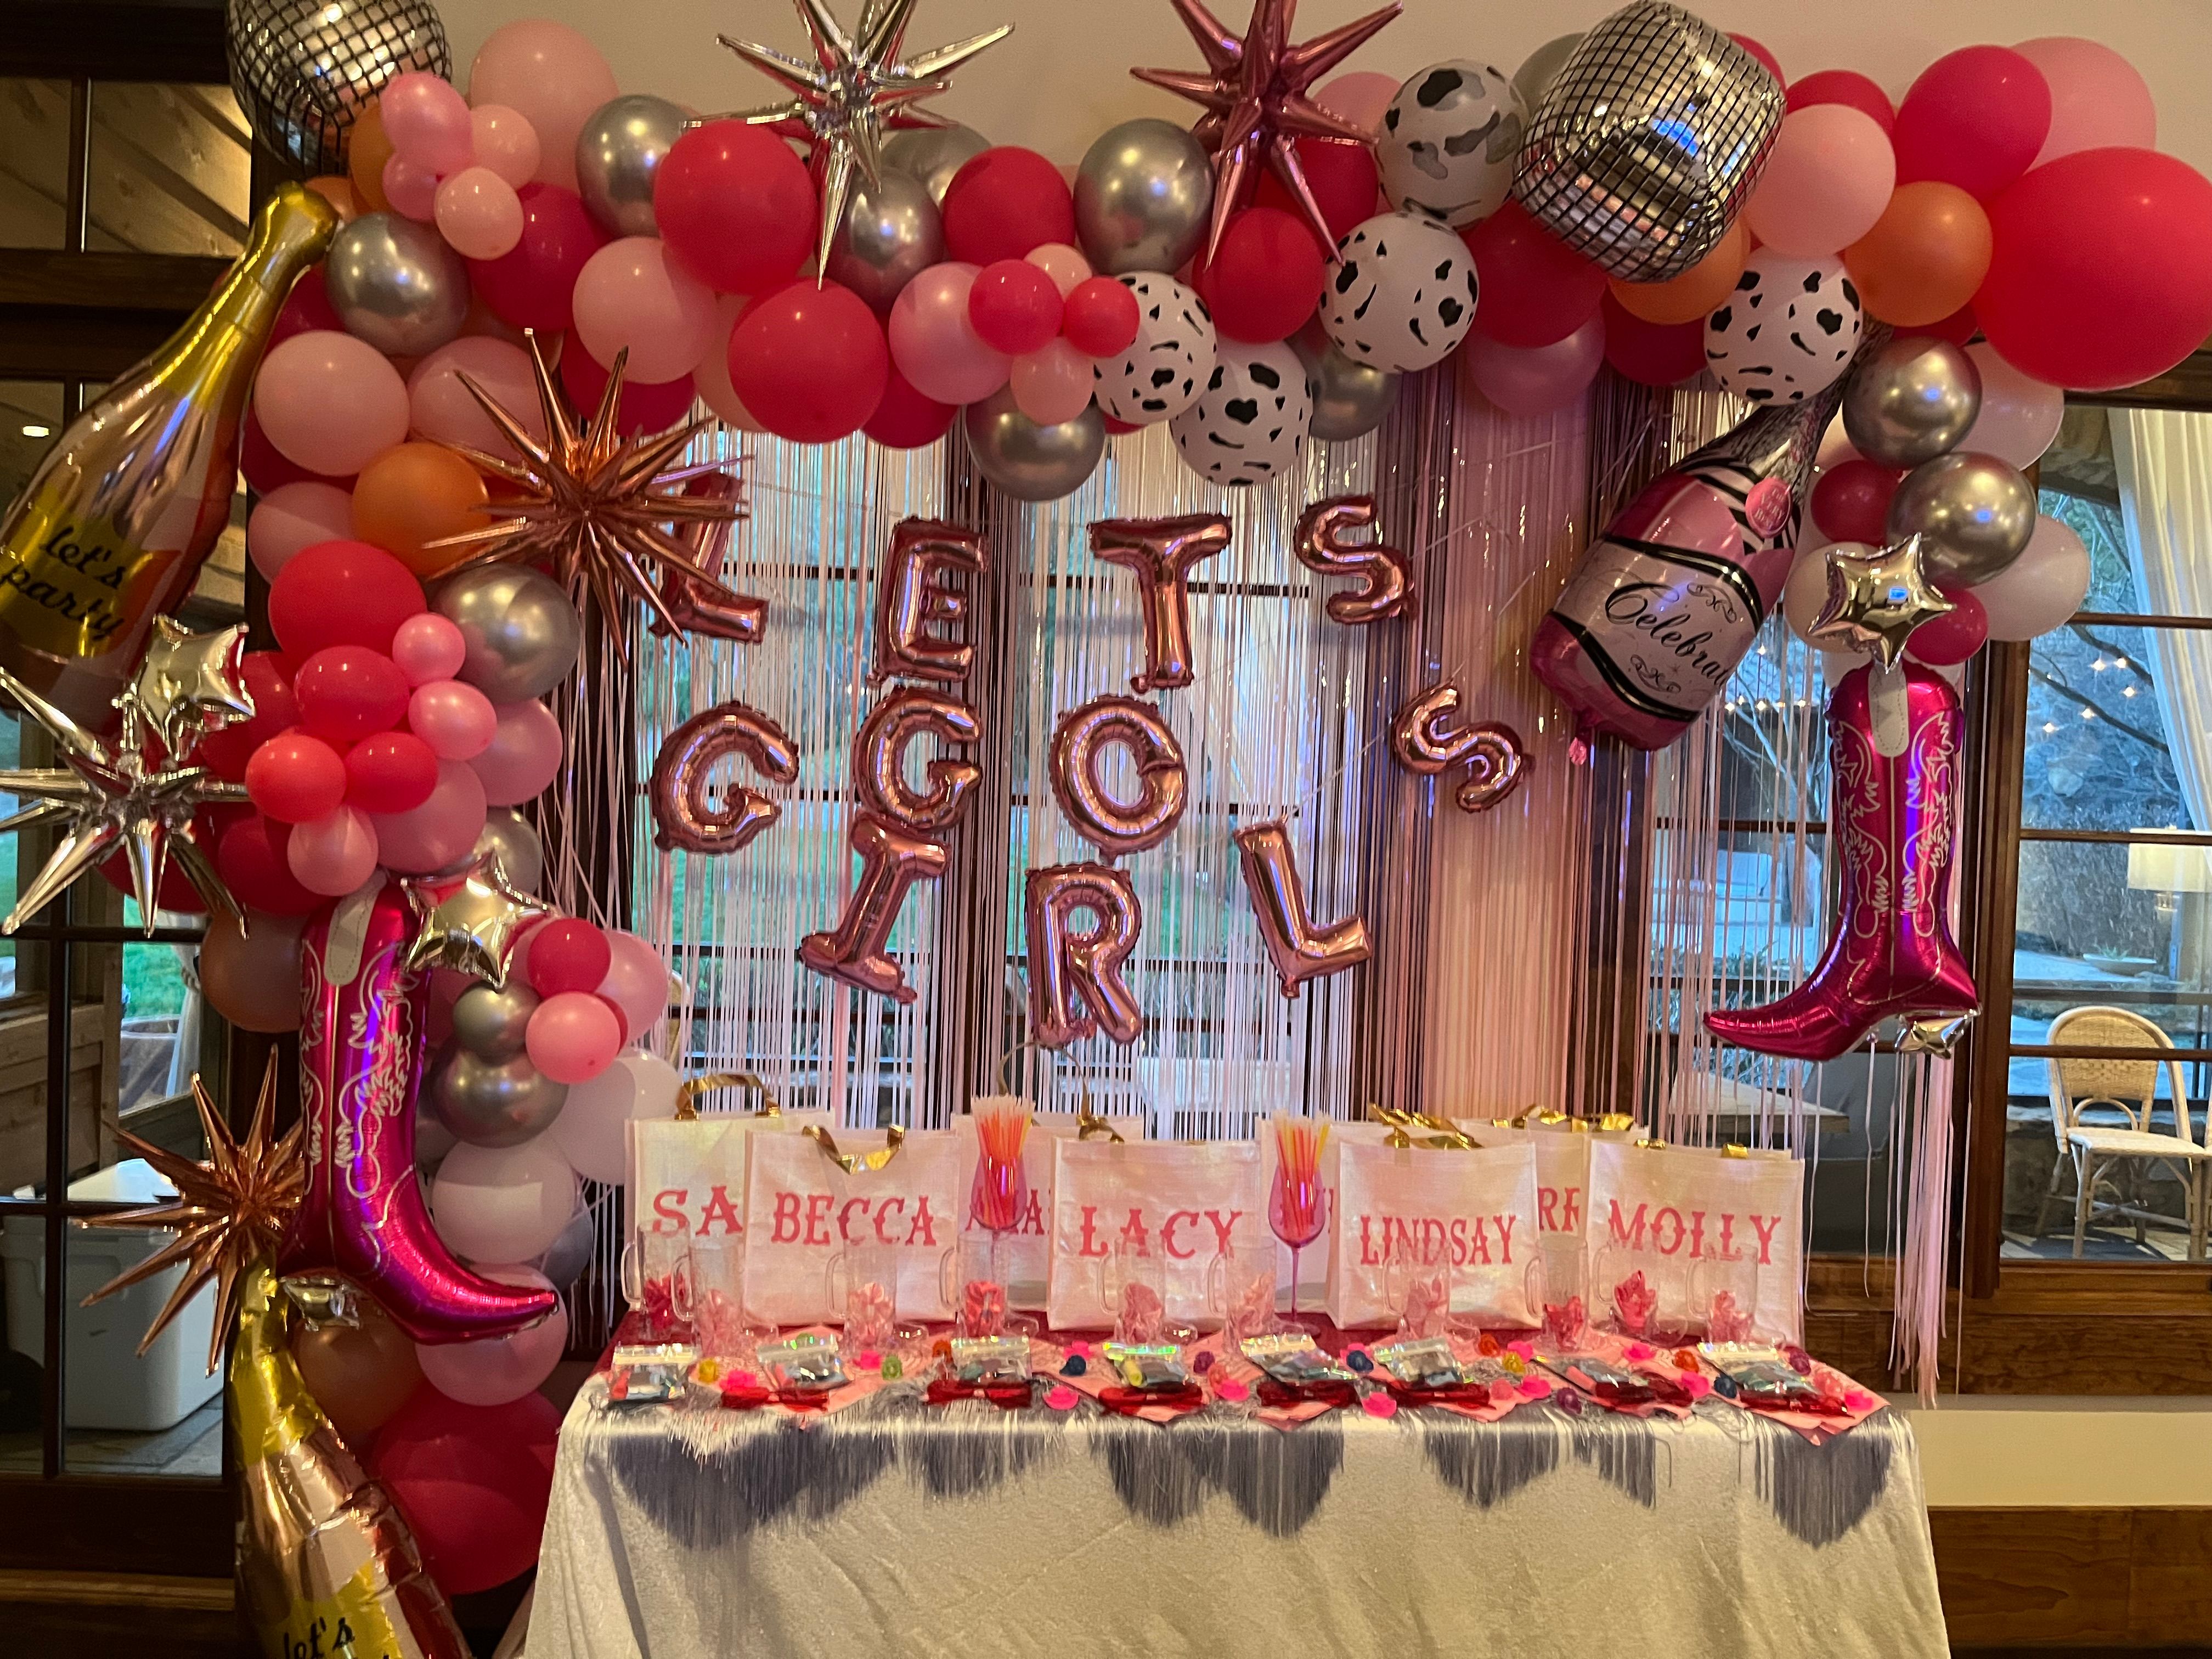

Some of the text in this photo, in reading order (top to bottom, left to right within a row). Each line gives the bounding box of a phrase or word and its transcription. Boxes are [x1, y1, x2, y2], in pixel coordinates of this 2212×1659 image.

[38, 526, 126, 590] let's
[0, 563, 125, 642] party
[770, 1192, 937, 1247] BECCA
[1079, 1206, 1243, 1260] LACY
[1360, 1214, 1516, 1266] LINDSAY
[1608, 1199, 1781, 1265] MOLLY
